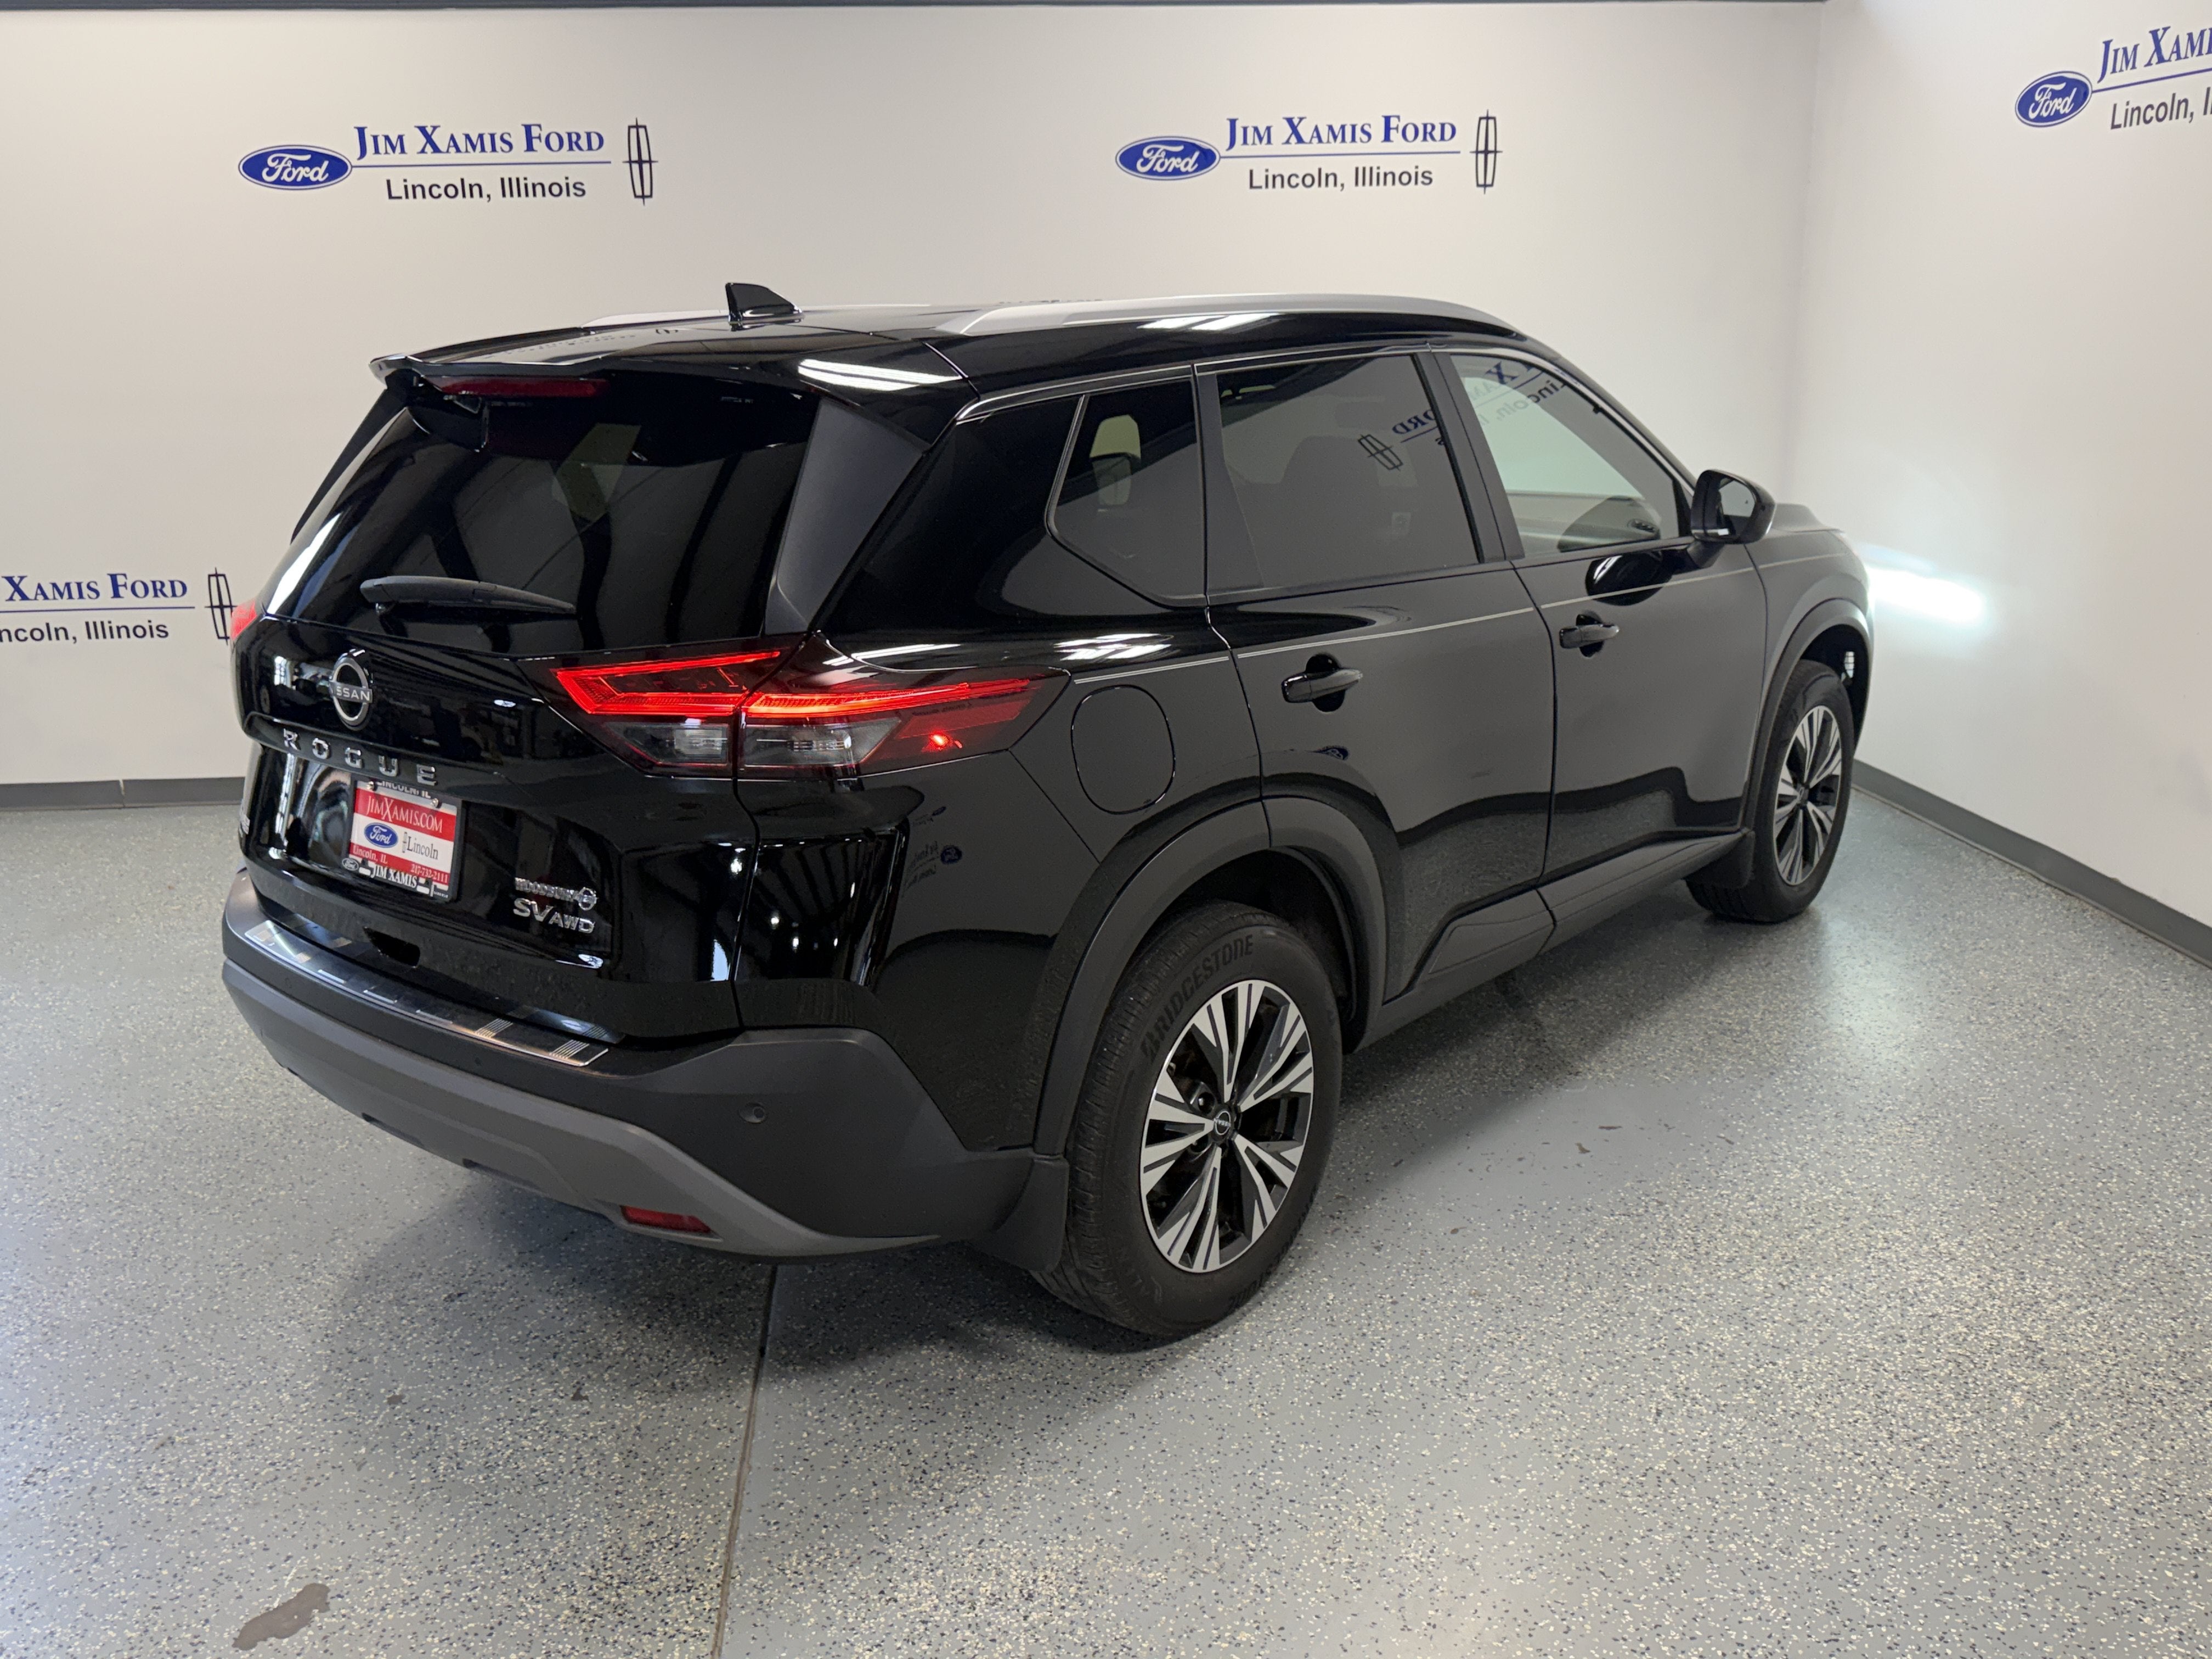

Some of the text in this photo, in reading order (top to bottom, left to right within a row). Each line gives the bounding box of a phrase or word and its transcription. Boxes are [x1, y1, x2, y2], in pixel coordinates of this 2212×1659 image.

[2097, 39, 2140, 83] JIM
[2029, 82, 2077, 119] Ford
[2111, 93, 2194, 130] Lincoln,
[354, 124, 604, 160] JIM XAMIS FORD
[1226, 115, 1456, 151] JIM XAMIS FORD
[262, 154, 329, 183] Ford
[1136, 144, 1199, 172] Ford
[386, 176, 585, 202] Lincoln, Illinois
[1249, 165, 1432, 191] Lincoln, Illinois
[2, 573, 187, 601] XAMIS FORD
[84, 619, 168, 640] Illinois
[283, 728, 437, 786] ROGUE
[366, 795, 443, 833] JIMXAMIS.COM
[370, 826, 392, 844] Ford
[407, 836, 438, 860] Lincoln
[380, 855, 388, 864] IL
[371, 864, 417, 888] JIM XAMIS
[513, 898, 554, 922] SV
[549, 911, 595, 934] AWD
[1140, 934, 1253, 1062] BRIDGESTONE
